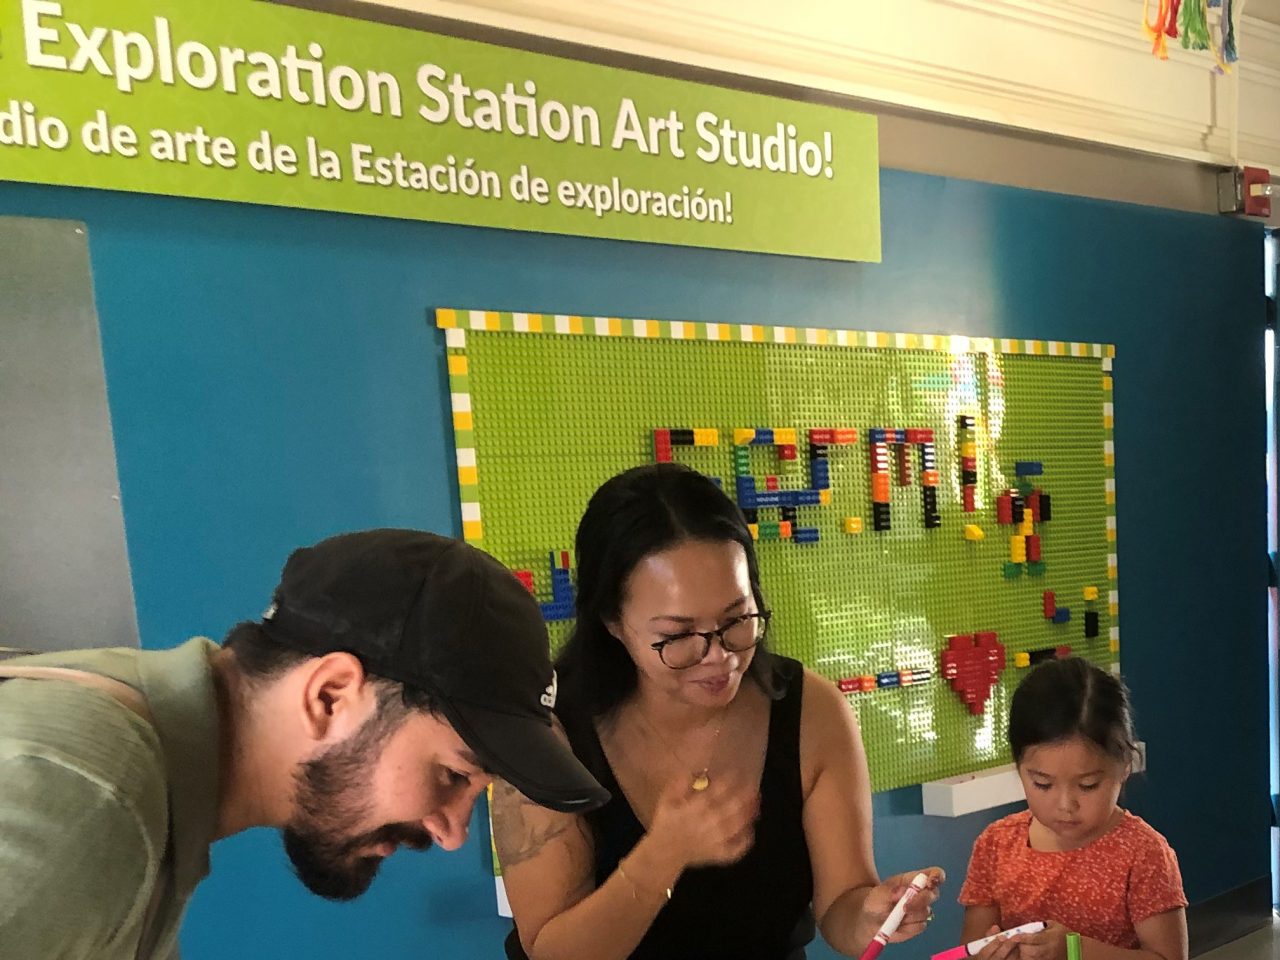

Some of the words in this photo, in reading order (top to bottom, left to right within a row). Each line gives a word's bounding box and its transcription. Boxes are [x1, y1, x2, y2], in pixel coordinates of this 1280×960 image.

[23, 0, 402, 116] Exploration
[418, 64, 600, 146] Station
[612, 100, 685, 158] Art
[696, 112, 834, 178] Studio!
[81, 109, 138, 156] de
[150, 127, 236, 167] arte
[247, 131, 297, 175] de
[308, 136, 341, 180] la
[352, 144, 501, 199] Estación
[510, 166, 549, 205] de
[557, 178, 733, 224] exploración!
